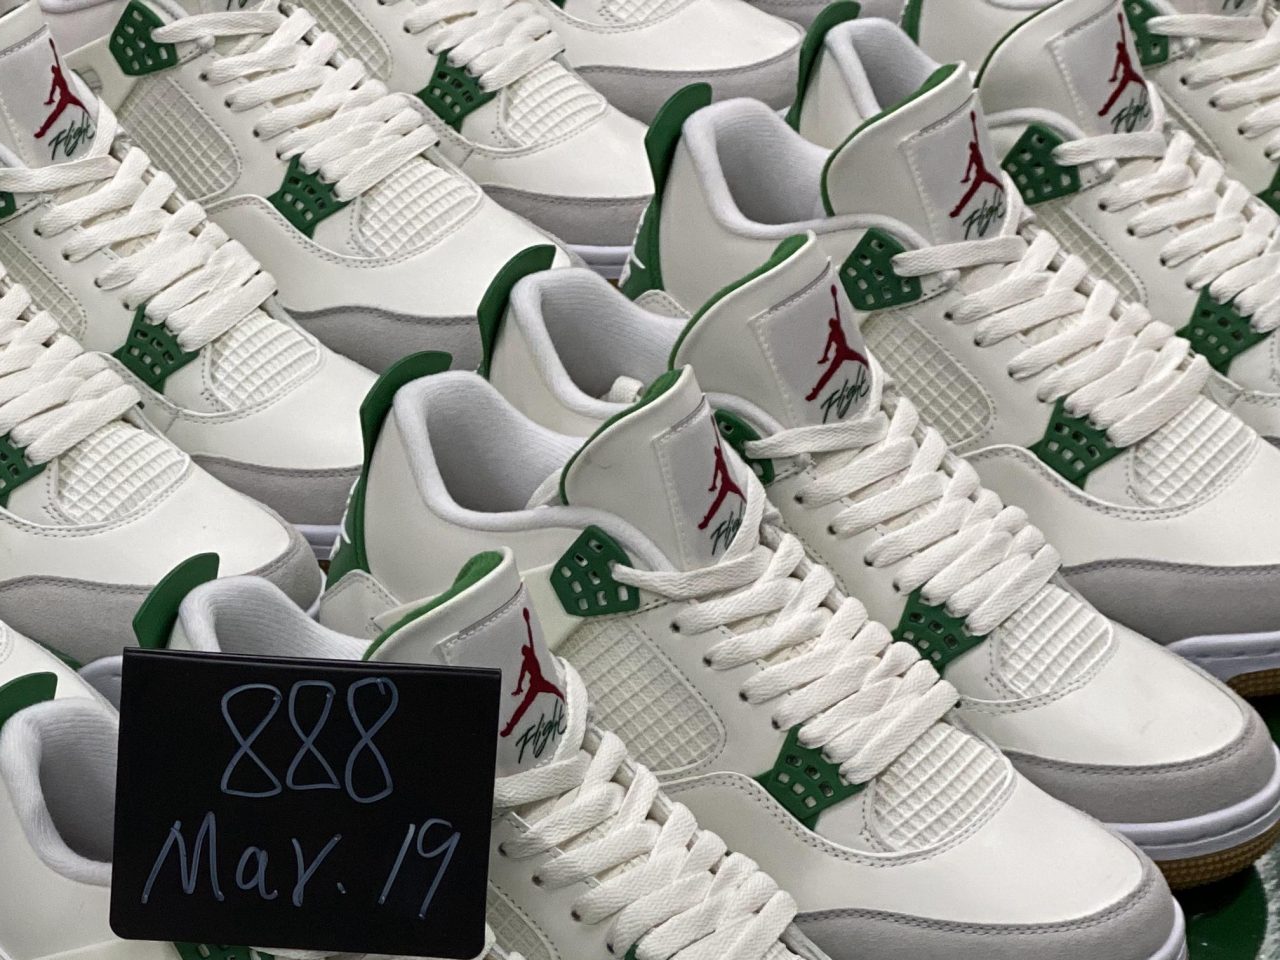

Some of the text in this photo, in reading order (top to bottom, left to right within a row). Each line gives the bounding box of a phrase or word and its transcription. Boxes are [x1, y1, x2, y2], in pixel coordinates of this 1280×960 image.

[49, 110, 94, 160] Flight
[822, 364, 871, 424] Flight
[220, 677, 400, 803] 888
[516, 698, 566, 763] Flight
[141, 811, 462, 920] Mar. 19
